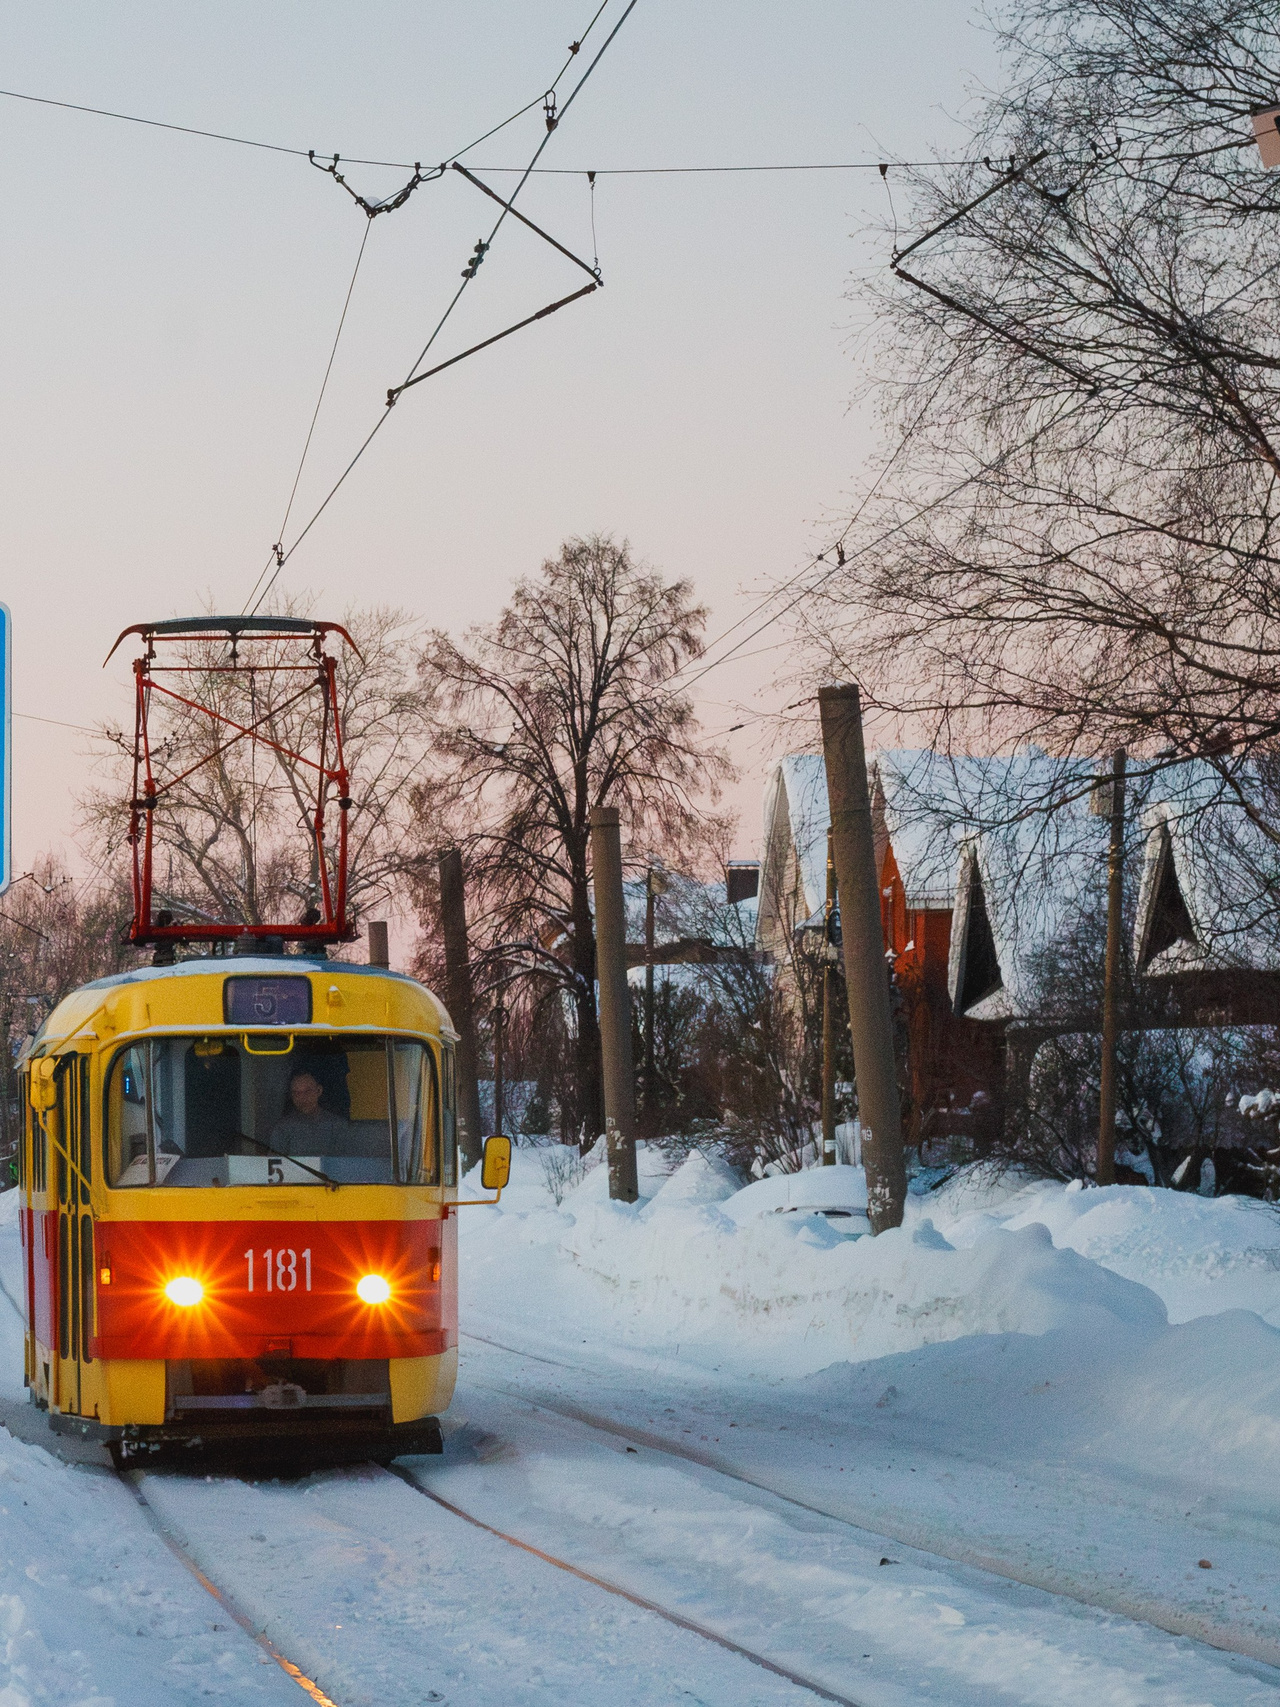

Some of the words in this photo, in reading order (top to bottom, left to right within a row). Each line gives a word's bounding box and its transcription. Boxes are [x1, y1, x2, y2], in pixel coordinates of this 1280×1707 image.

[253, 982, 280, 1018] 5
[267, 1158, 285, 1184] 5
[244, 1248, 312, 1293] 1181
